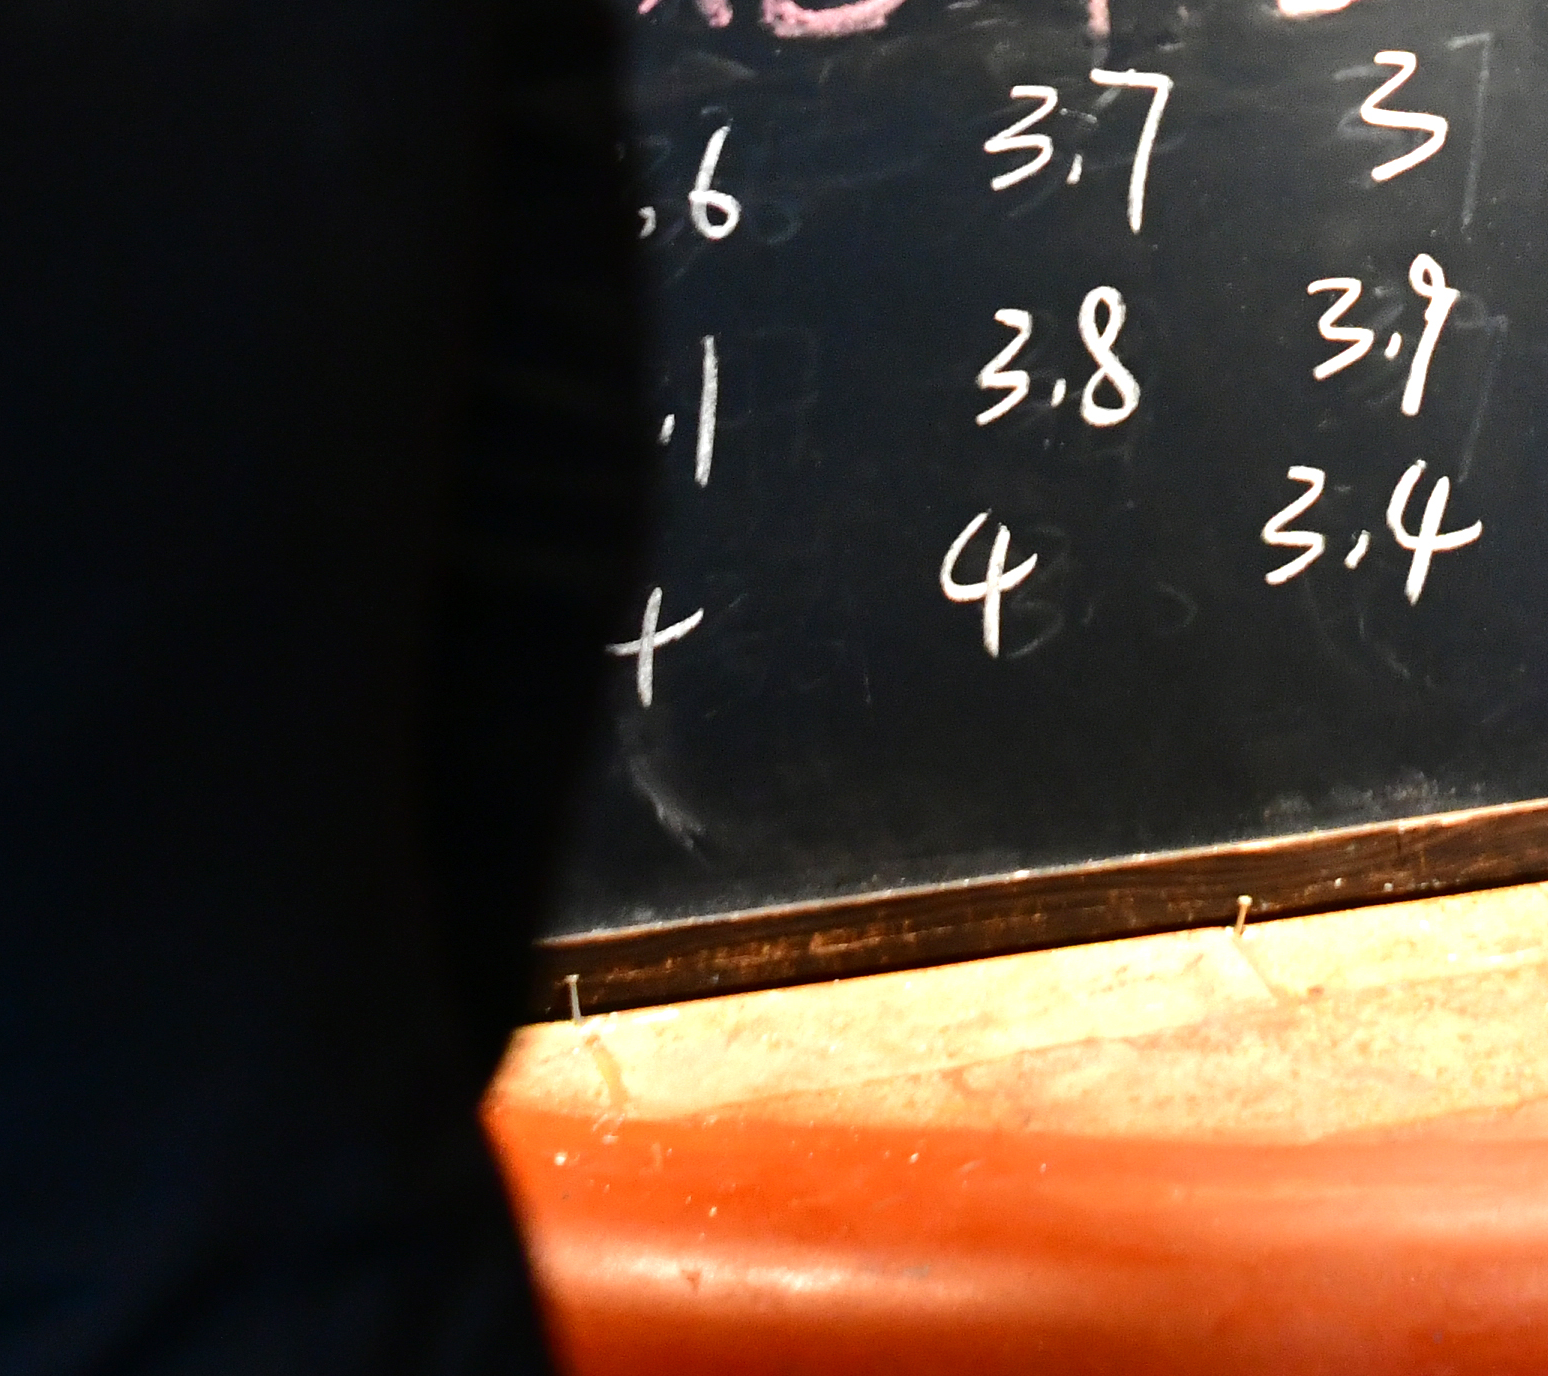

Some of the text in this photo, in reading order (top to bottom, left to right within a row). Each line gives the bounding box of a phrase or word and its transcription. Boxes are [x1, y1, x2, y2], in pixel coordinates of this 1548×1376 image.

[984, 68, 1173, 231] 3.7
[1359, 51, 1448, 181] 3
[977, 286, 1140, 425] 3.8
[941, 513, 1037, 654] 4
[1263, 460, 1482, 602] 3.4
